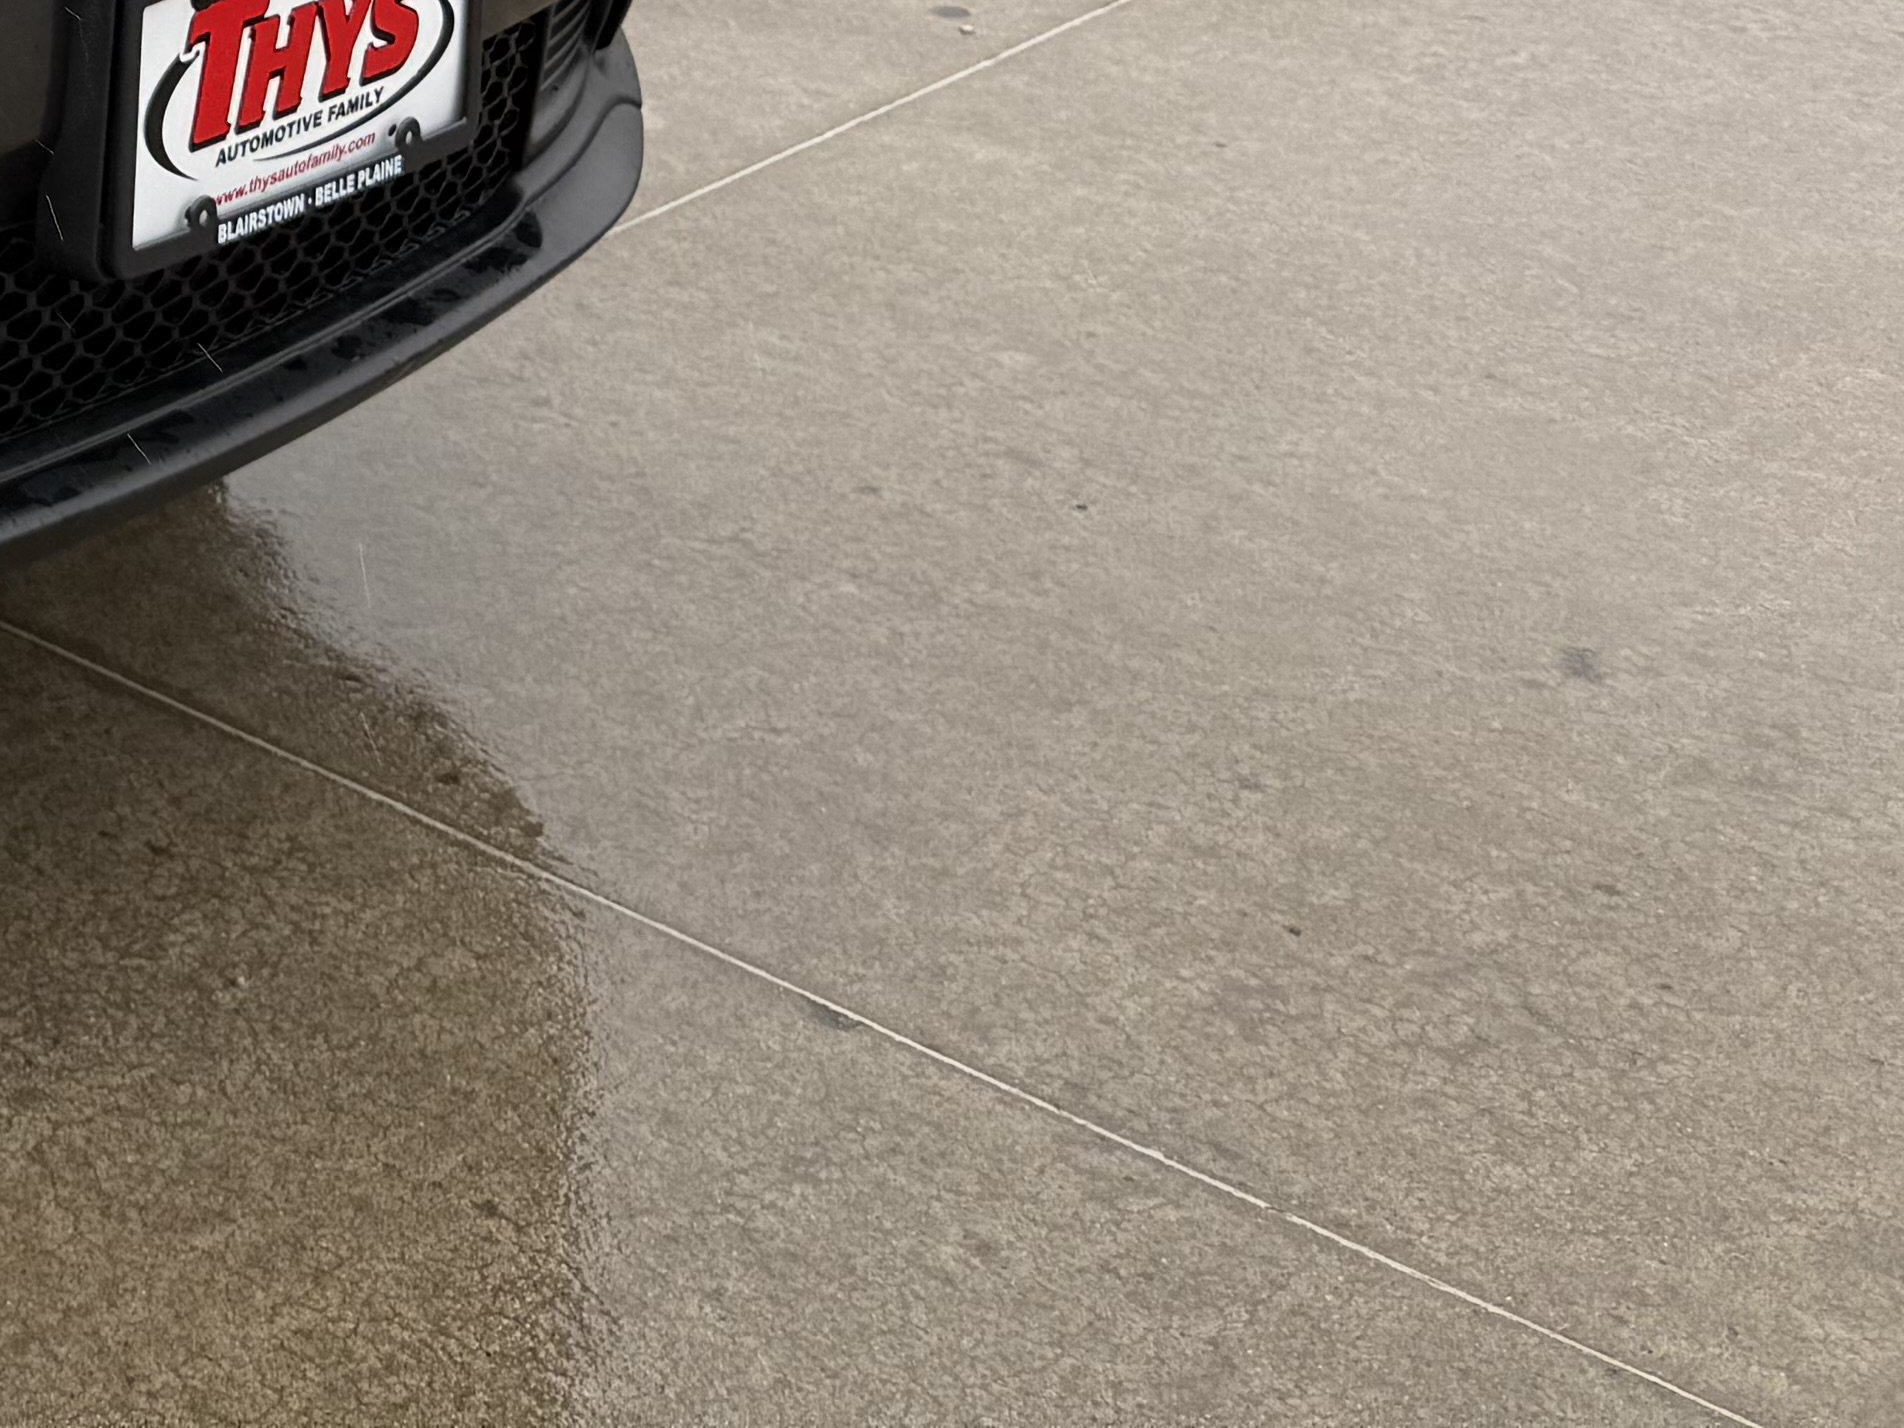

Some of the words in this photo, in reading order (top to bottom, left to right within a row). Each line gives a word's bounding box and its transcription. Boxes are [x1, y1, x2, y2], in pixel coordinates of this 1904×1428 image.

[215, 110, 323, 167] AUTOMOTIVE
[327, 86, 384, 123] FAMILY
[218, 193, 305, 244] BLAIRSTOWN
[315, 174, 355, 207] BELLE
[357, 154, 403, 190] PLAINE
